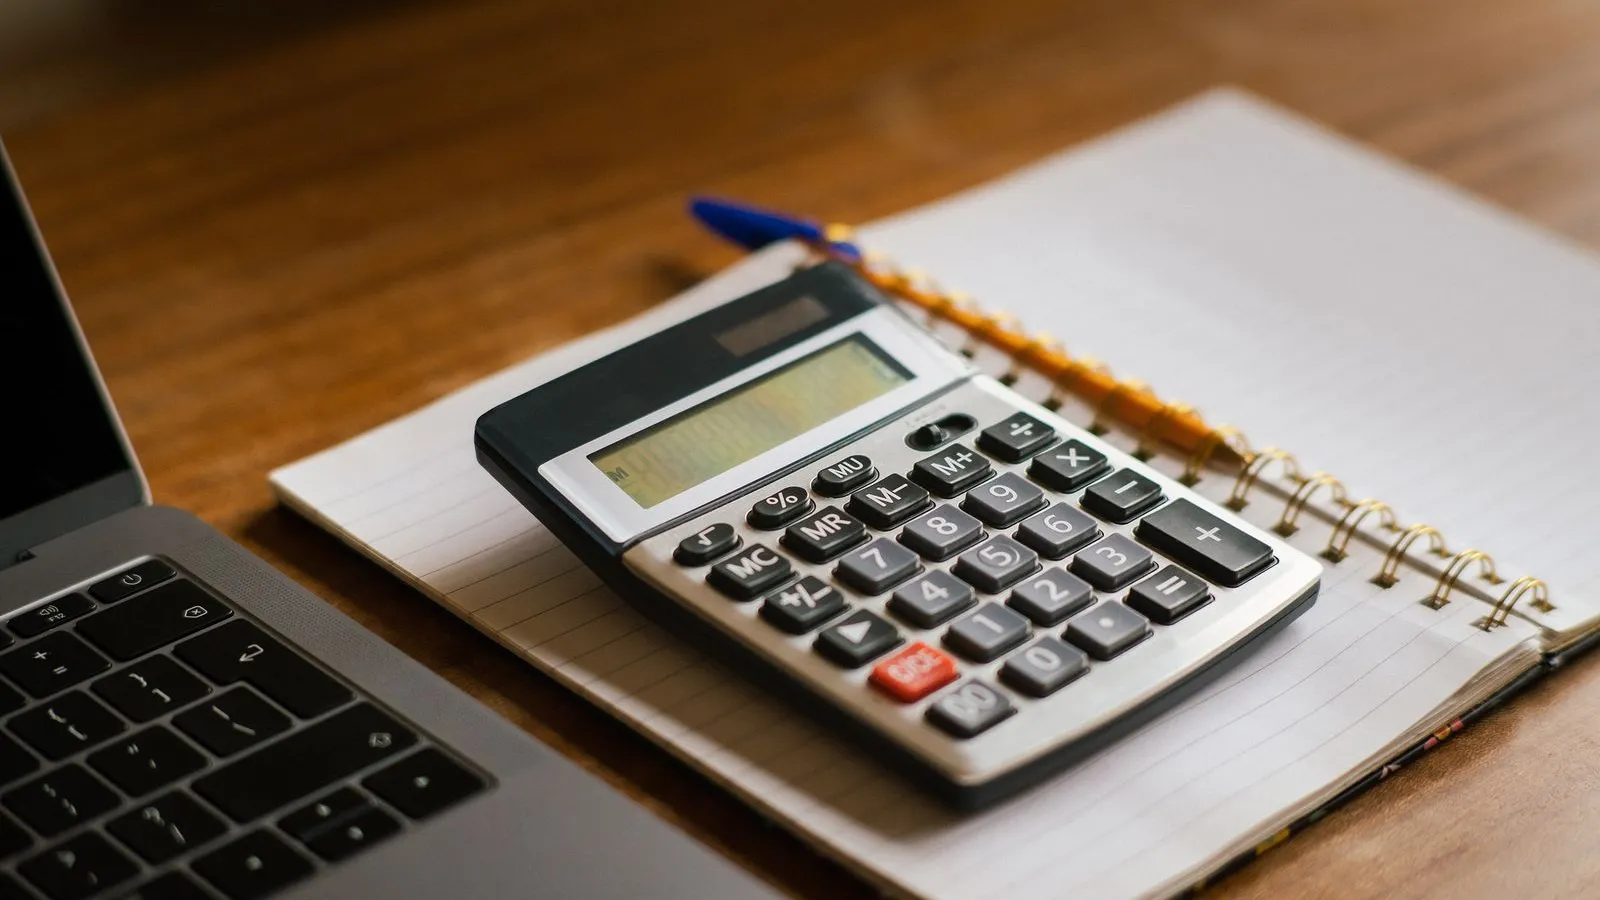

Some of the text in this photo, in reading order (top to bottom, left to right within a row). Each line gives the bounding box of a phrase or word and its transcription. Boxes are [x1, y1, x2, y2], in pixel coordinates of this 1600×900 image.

[606, 466, 630, 482] M
[835, 456, 864, 480] MU
[931, 451, 973, 477] M+
[765, 491, 799, 509] %
[865, 483, 908, 507] M-
[989, 484, 1018, 503] 9
[800, 512, 851, 542] MR
[926, 515, 959, 536] 8
[1043, 513, 1073, 533] 6
[1195, 525, 1222, 543] +
[727, 546, 779, 579] MC
[860, 547, 888, 570] 7
[977, 544, 1013, 567] 5
[1095, 546, 1128, 567] 3
[920, 578, 949, 600] 4
[1033, 578, 1070, 601] 2
[1155, 574, 1188, 596] =
[971, 613, 1005, 634] 1
[1025, 648, 1057, 671] 0
